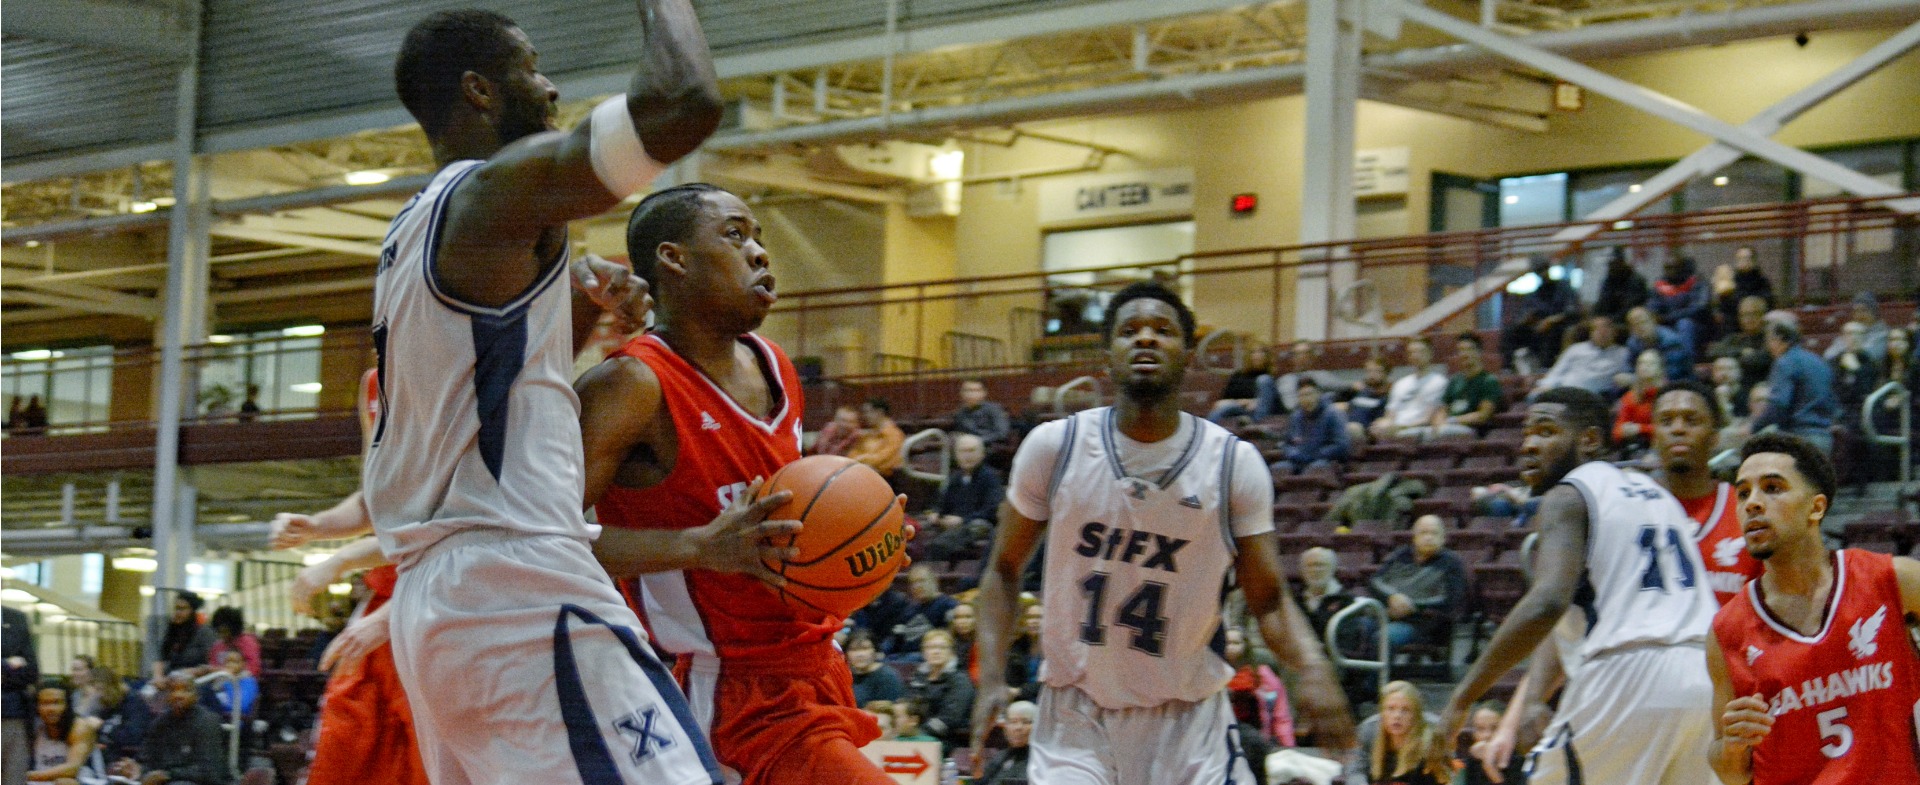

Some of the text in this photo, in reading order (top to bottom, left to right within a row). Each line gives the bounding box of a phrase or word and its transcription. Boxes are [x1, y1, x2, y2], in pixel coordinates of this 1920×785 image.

[1076, 521, 1191, 573] StFX
[1637, 524, 1696, 592] 11
[1078, 570, 1169, 657] 14
[1768, 661, 1893, 717] EA-HAWKS
[612, 703, 678, 767] X
[1816, 706, 1854, 759] 5
